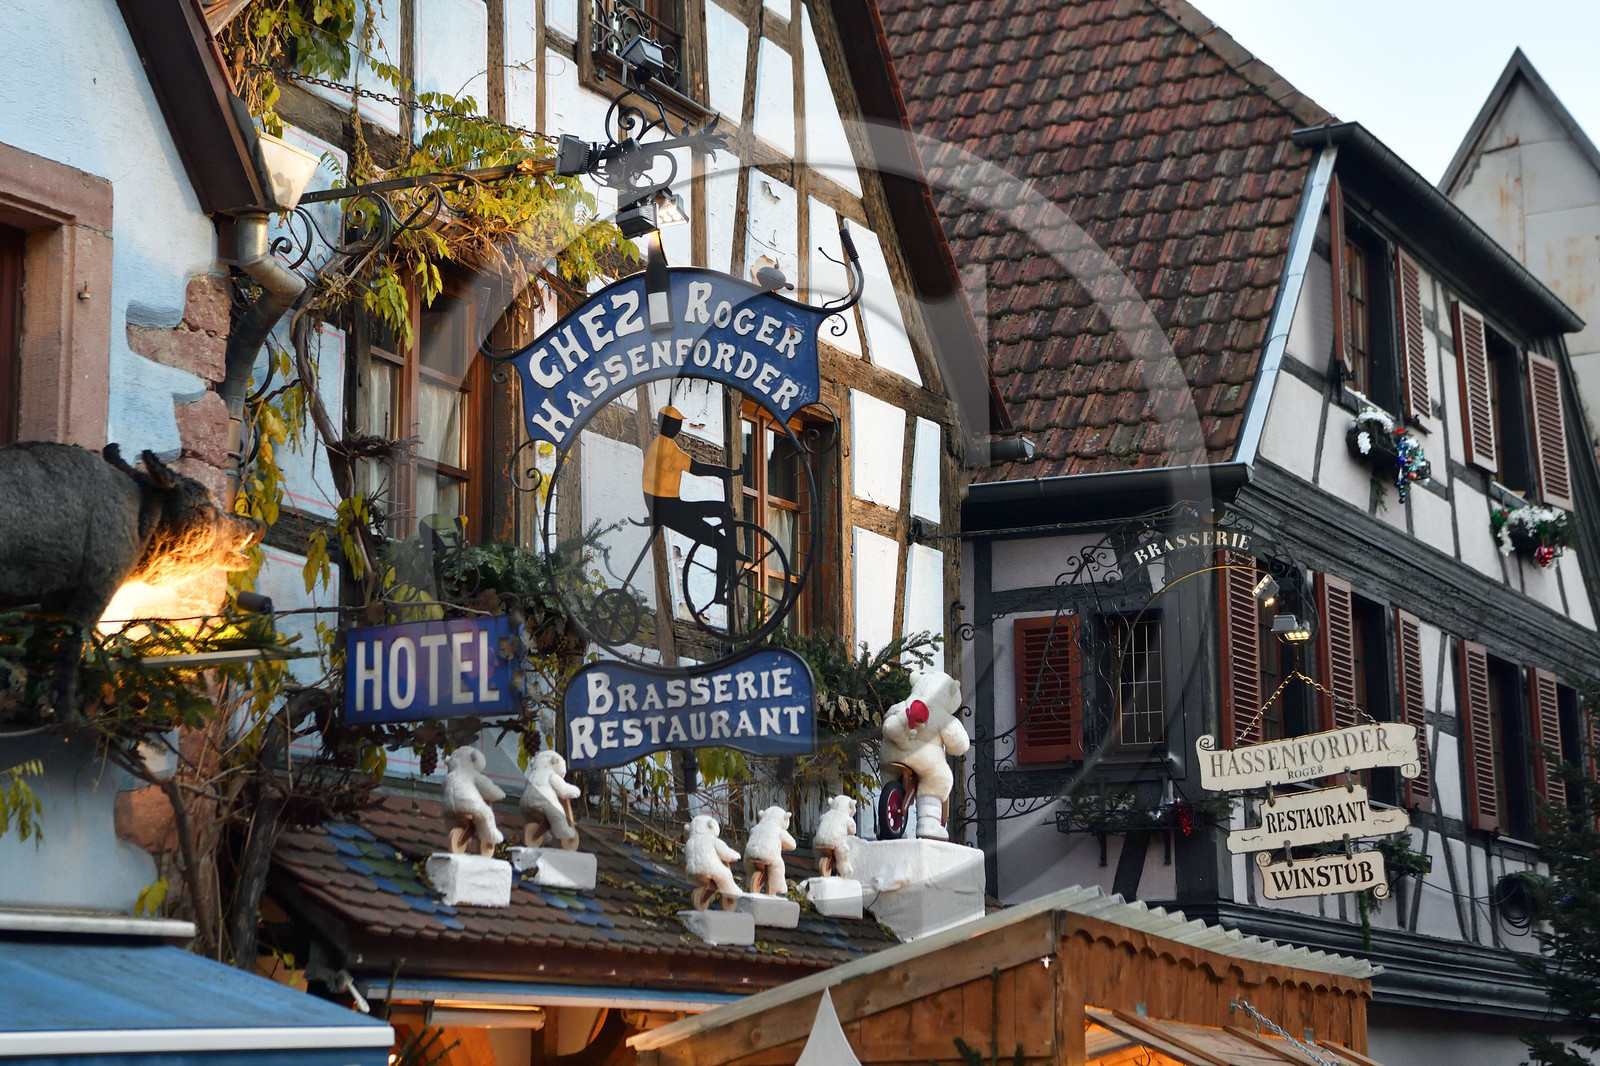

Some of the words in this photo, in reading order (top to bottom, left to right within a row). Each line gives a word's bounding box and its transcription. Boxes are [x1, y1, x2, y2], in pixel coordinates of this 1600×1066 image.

[529, 289, 645, 388] CHEZ
[684, 281, 802, 359] ROGER
[532, 337, 799, 443] HASSENFORDER
[1134, 531, 1252, 565] BRASSERIE
[355, 631, 500, 711] HOTEL
[587, 667, 793, 716] BRASSERIE
[570, 705, 805, 761] RESTAURANT
[1209, 728, 1391, 778] HASSENFORDER
[1287, 766, 1325, 780] ROGER
[1266, 801, 1367, 834] RESTAURANT
[1270, 861, 1374, 892] WINSTUB
